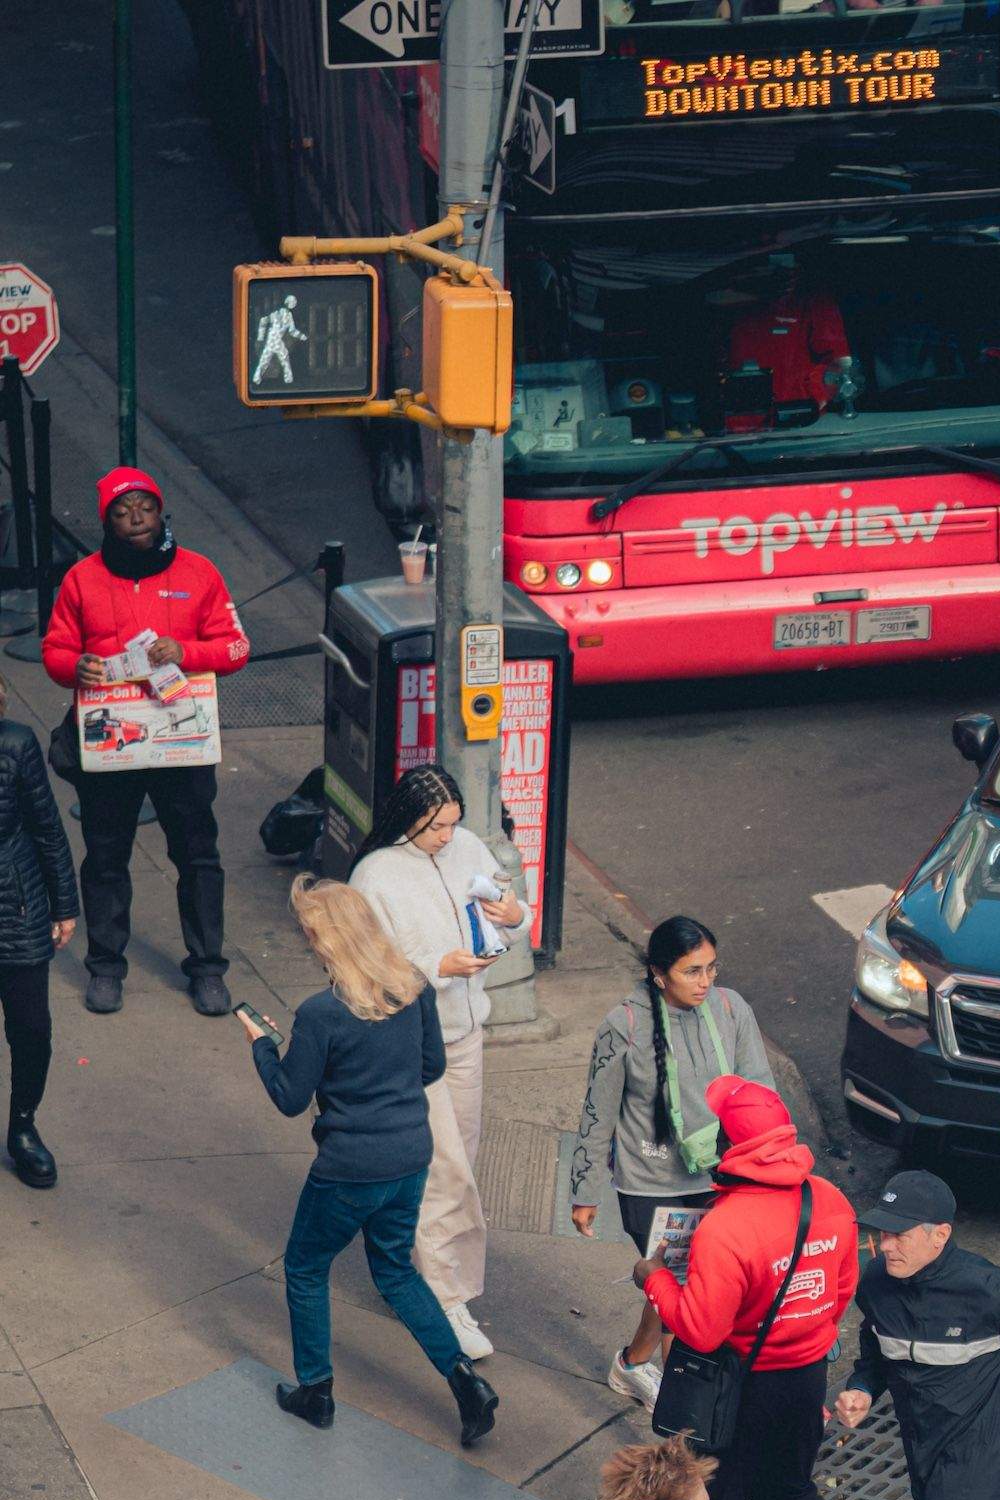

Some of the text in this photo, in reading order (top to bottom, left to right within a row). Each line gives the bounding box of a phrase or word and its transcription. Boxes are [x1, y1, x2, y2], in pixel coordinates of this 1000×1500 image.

[370, 1, 440, 35] ONE
[645, 73, 936, 117] DOWNTOWN TOUR
[0, 312, 37, 335] OP
[502, 663, 548, 683] ILLER
[503, 685, 532, 701] ANNA
[501, 732, 546, 774] AD
